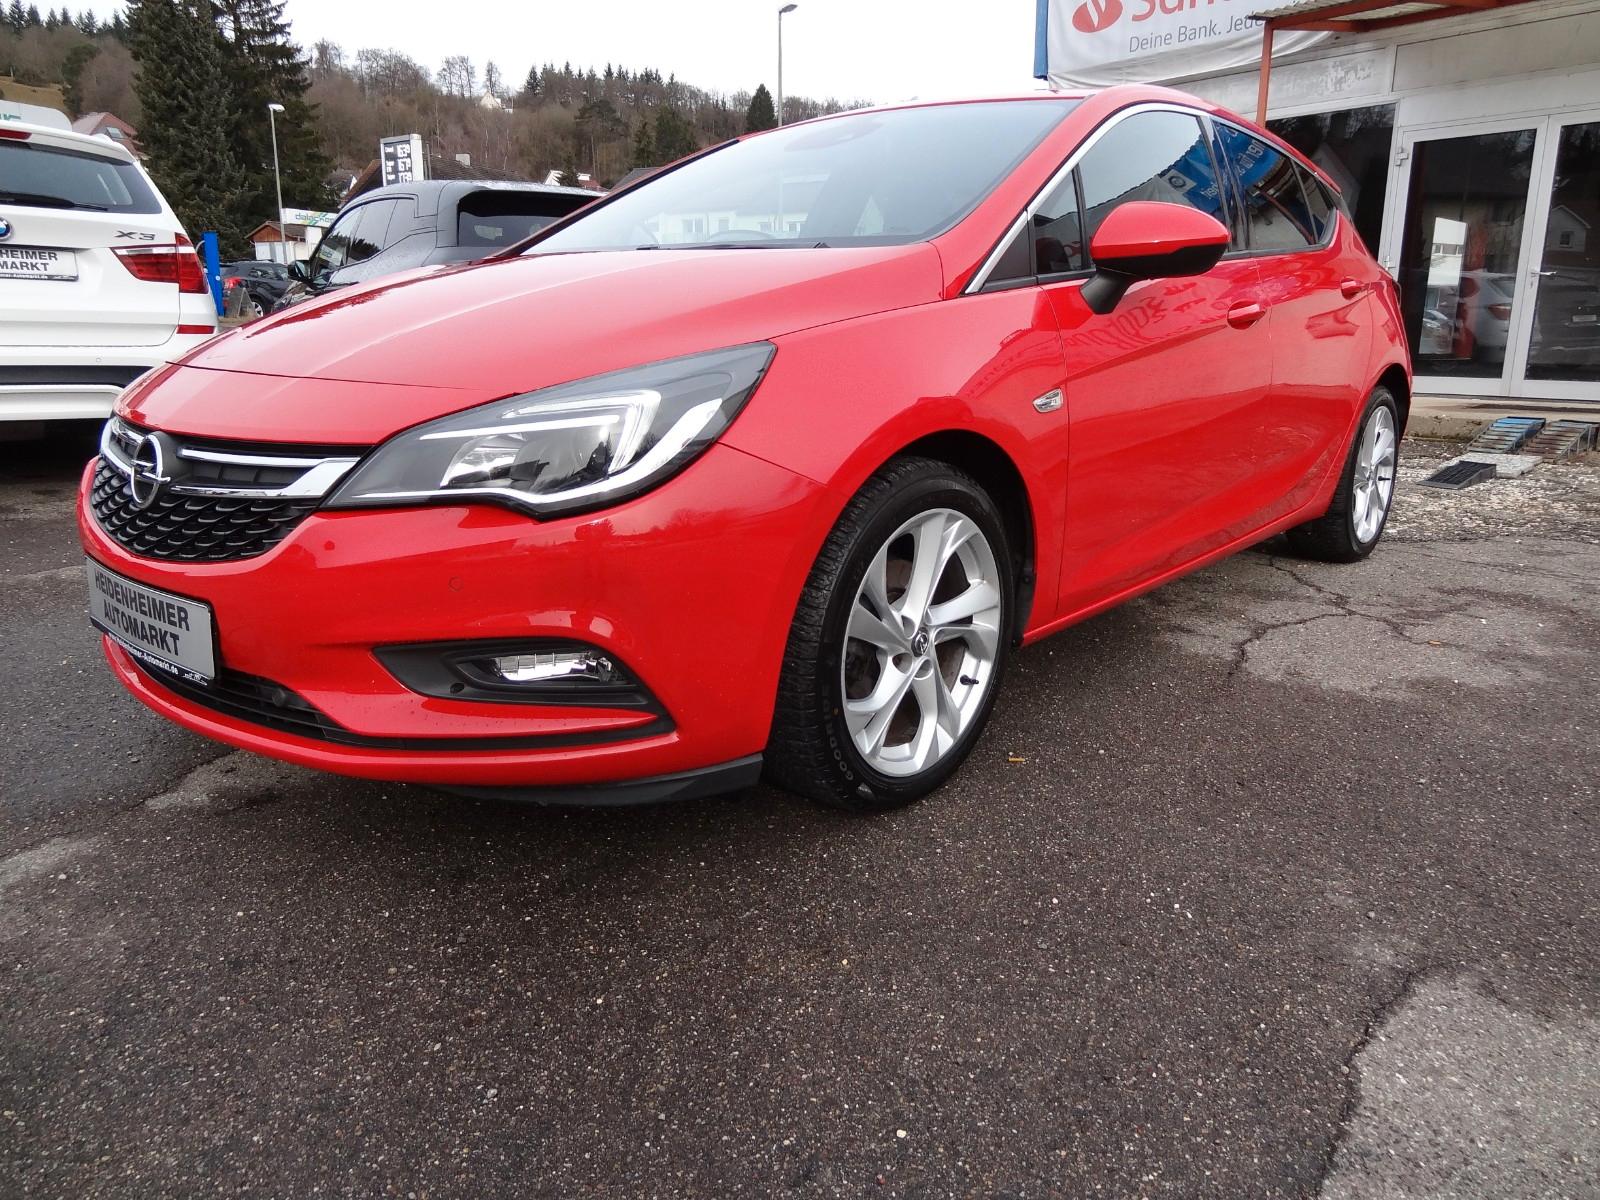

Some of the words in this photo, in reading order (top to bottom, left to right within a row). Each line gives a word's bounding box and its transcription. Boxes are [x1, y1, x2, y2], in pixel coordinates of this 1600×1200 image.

[1129, 32, 1172, 53] Deine
[1178, 19, 1222, 43] Bank.
[114, 230, 155, 241] X3
[94, 567, 190, 631] HEIDENHEIMER
[103, 598, 180, 656] AUTOMARKT
